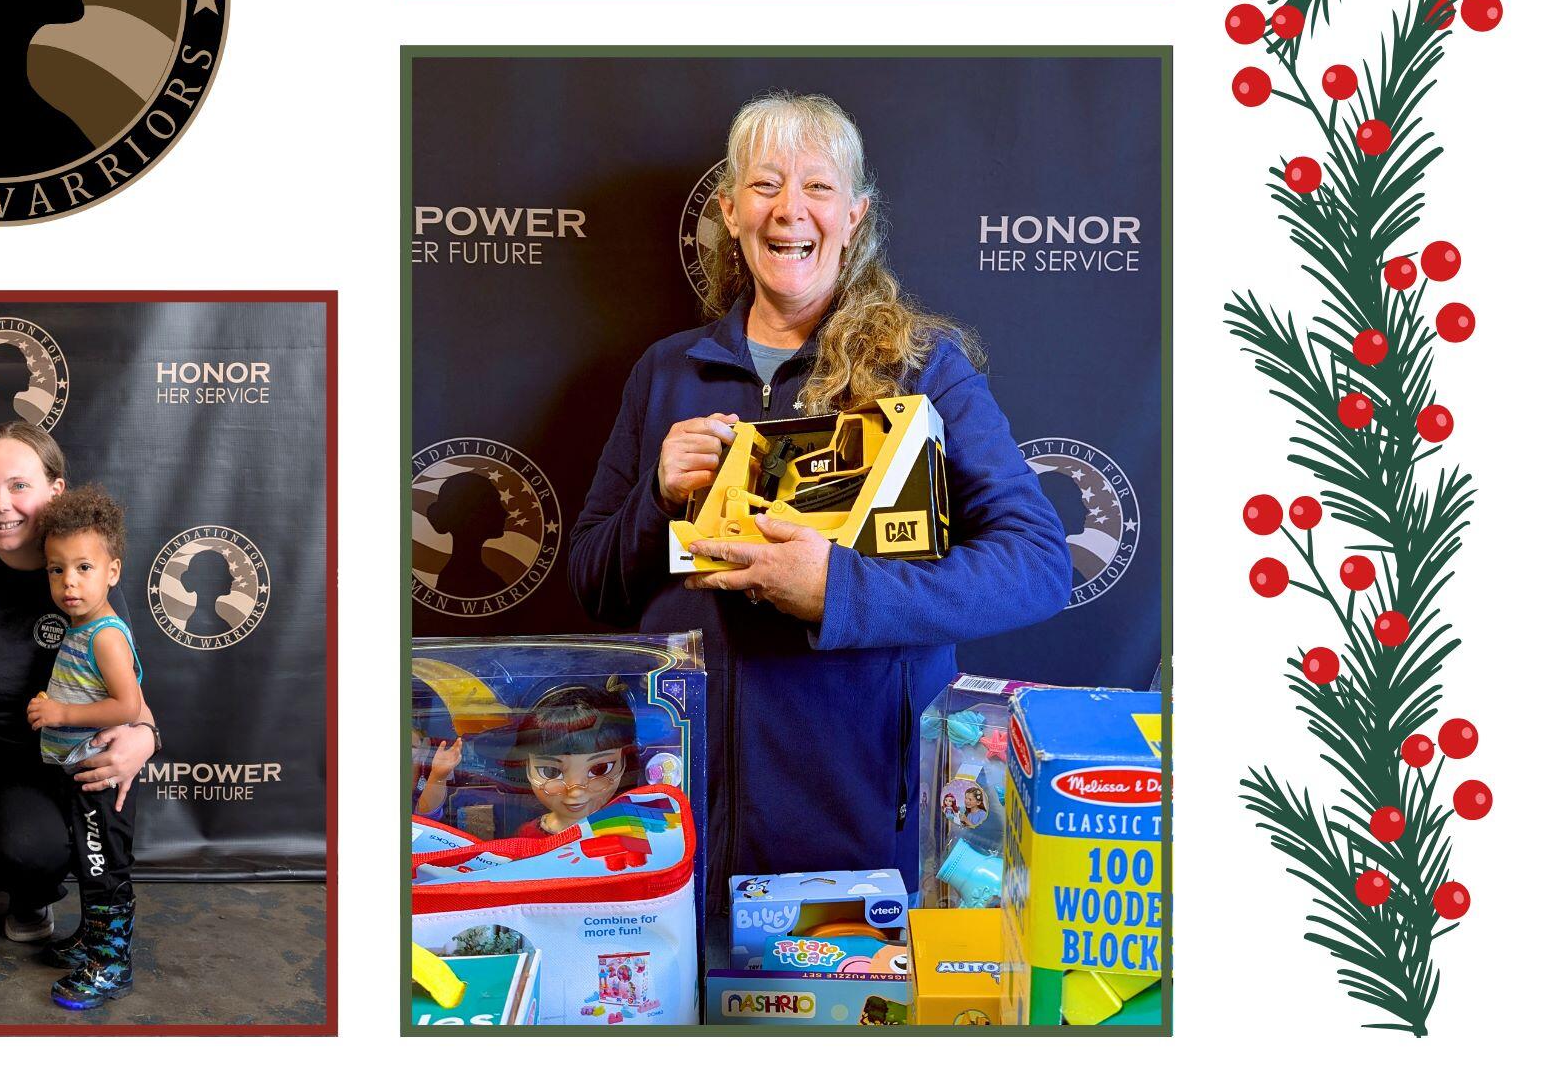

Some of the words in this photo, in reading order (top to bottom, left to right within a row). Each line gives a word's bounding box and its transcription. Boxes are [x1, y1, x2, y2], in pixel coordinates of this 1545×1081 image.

[415, 206, 587, 238] POWER
[979, 216, 1141, 244] HONOR
[412, 241, 439, 264] ER
[449, 242, 543, 265] FUTURE
[980, 250, 1026, 272] HER
[1034, 250, 1140, 272] SERVICE
[41, 336, 62, 364] FOR
[157, 362, 270, 384] HONOR
[157, 388, 189, 404] HER
[195, 387, 270, 404] SERVICE
[414, 441, 514, 471] NDATION
[521, 463, 550, 500] FOR
[810, 459, 830, 473] CAT
[1102, 464, 1130, 499] FOR
[885, 521, 918, 543] CAT
[154, 528, 239, 575] FOUNDATION
[243, 544, 263, 570] FOR
[412, 578, 449, 610] MEN
[461, 544, 555, 614] WARRIORS
[1069, 543, 1133, 605] RRIORS
[41, 625, 64, 635] NATURE
[153, 602, 193, 645] WOMEN
[201, 601, 265, 648] WARRIORS
[42, 632, 61, 641] CALLS
[157, 785, 188, 801] HER
[194, 785, 254, 801] FUTURE
[1067, 775, 1130, 795] Melissa
[84, 810, 103, 852] WILD
[1055, 812, 1142, 835] CLASSIC
[1089, 847, 1154, 886] 100
[871, 906, 902, 916] vtech
[1054, 886, 1161, 928] WOODE
[584, 916, 638, 926] Combine
[641, 915, 658, 924] for
[584, 928, 616, 938] more
[619, 926, 642, 936] fun!
[776, 940, 840, 955] Potato
[1061, 929, 1161, 972] BLOCK
[779, 951, 835, 967] Head
[826, 972, 866, 980] PUZZLE
